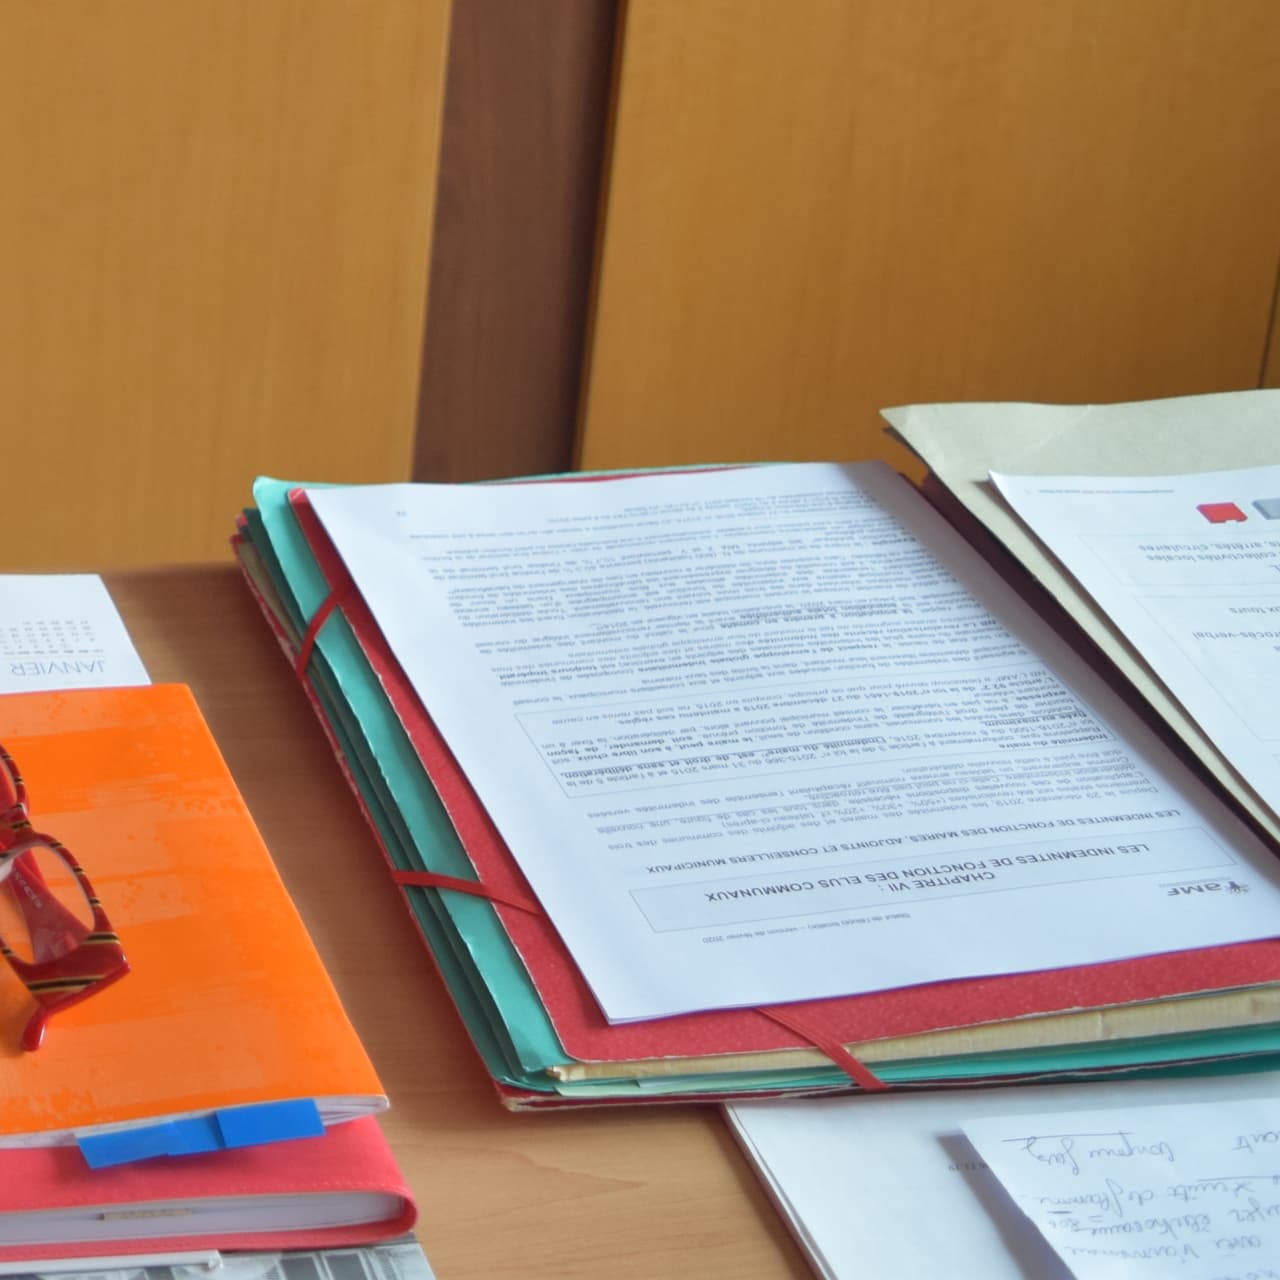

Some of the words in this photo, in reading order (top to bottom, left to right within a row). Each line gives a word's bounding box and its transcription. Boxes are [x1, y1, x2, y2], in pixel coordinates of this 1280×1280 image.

[9, 659, 105, 677] JANVIER
[1074, 810, 1154, 825] INDEMNITES
[1152, 808, 1182, 818] LES
[959, 827, 989, 837] DES
[987, 819, 1056, 834] FONCTION
[838, 836, 905, 851] ADJOINTS
[905, 830, 960, 843] MAIRES,
[727, 846, 820, 865] CONSEILLERS
[1014, 846, 1116, 865] INDEMNITES
[1115, 842, 1151, 854] LES
[645, 857, 728, 874] MUNICIPAUX
[899, 859, 988, 878] FONCTION
[988, 857, 1015, 868] DE
[815, 873, 862, 888] ELUS
[862, 869, 900, 882] DES
[911, 870, 997, 889] CHAPITRE
[703, 879, 815, 902] COMMUNAUX
[886, 880, 911, 892] VII
